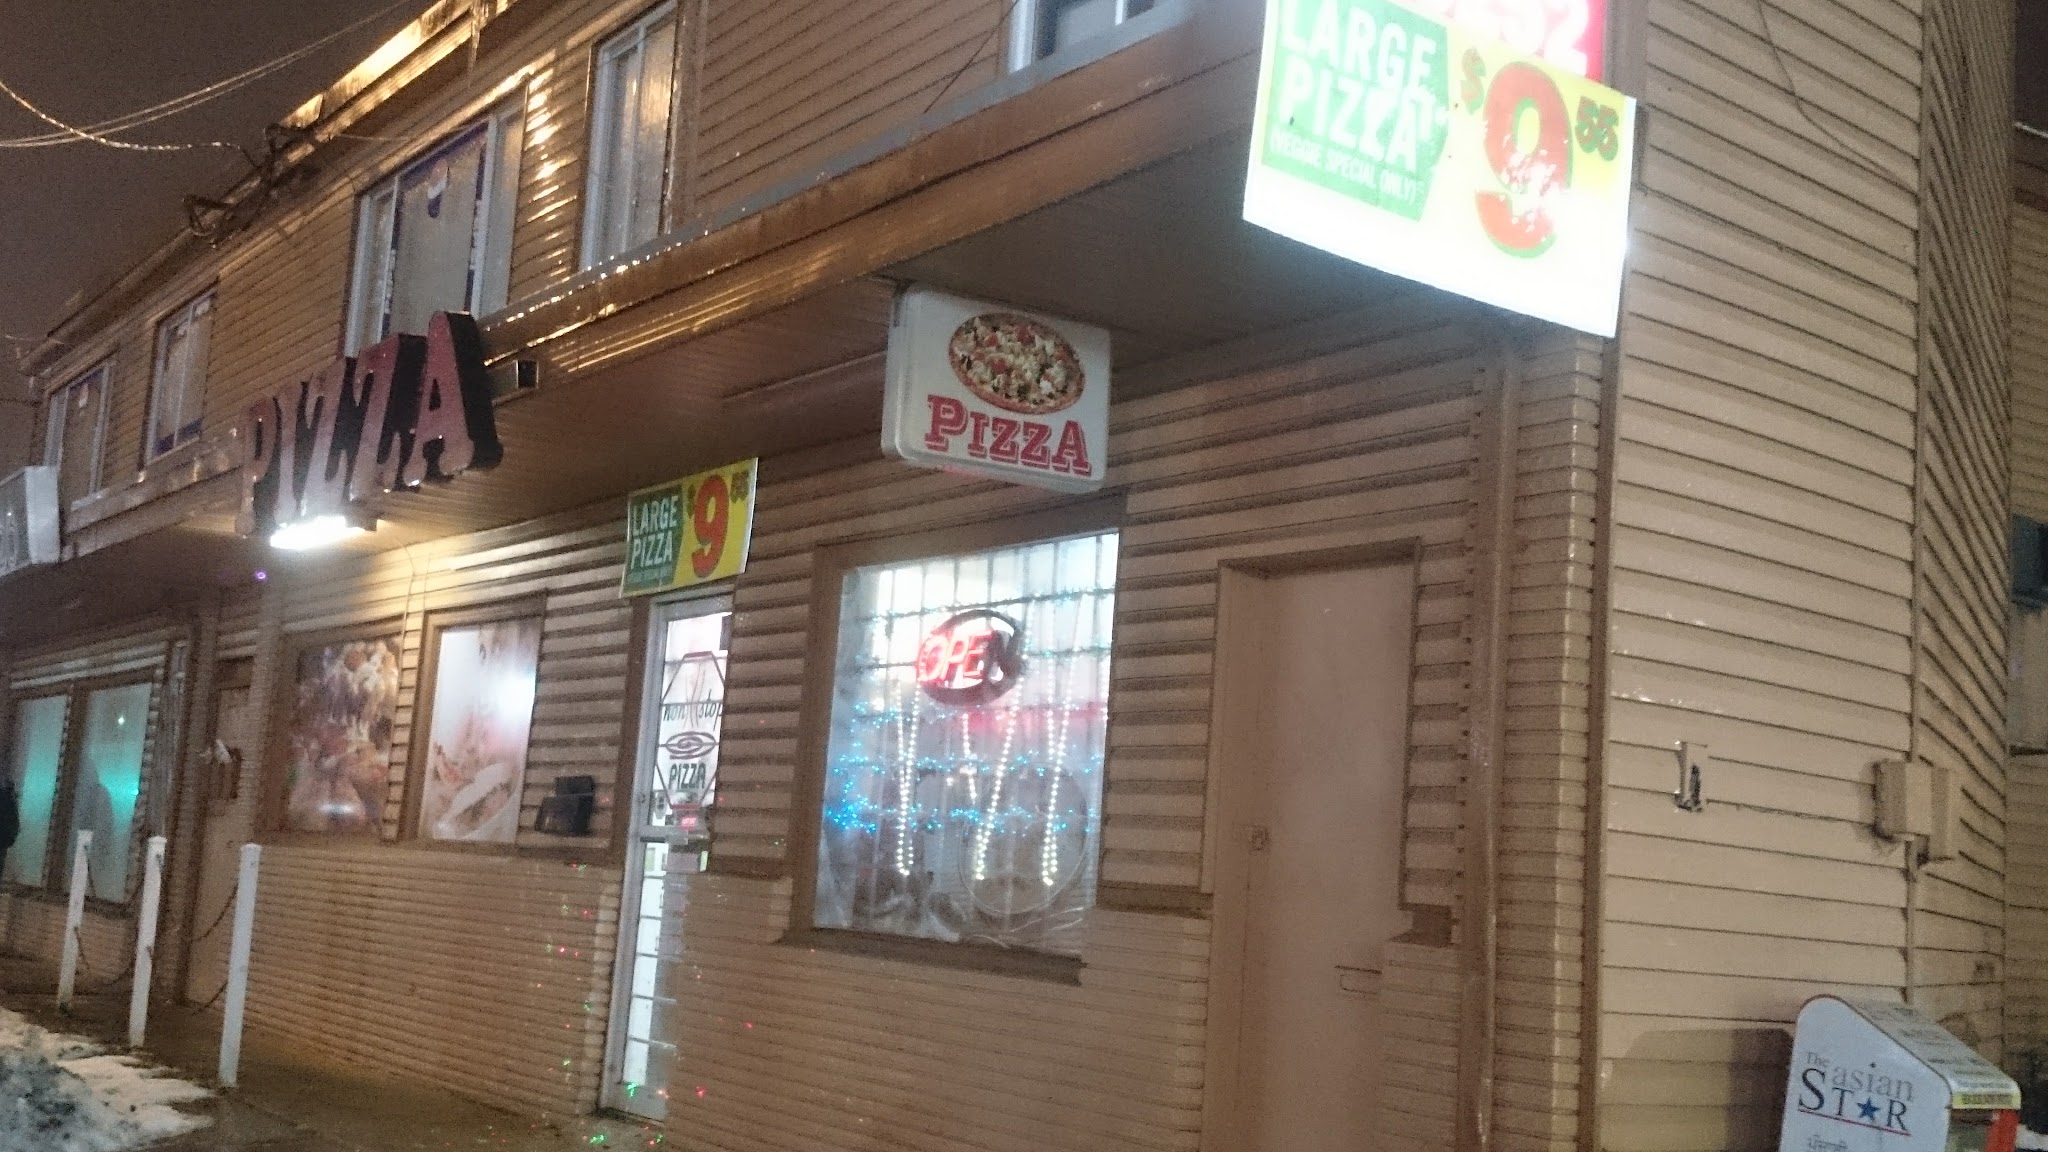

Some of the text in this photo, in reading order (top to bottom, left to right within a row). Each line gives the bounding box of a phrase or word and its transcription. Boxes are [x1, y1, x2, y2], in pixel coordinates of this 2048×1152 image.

[1281, 0, 1437, 89] LARGE
[1278, 53, 1418, 173] PIZZA
[924, 393, 1093, 478] PIZZA
[632, 496, 679, 536] LARGE
[630, 530, 673, 570] PIZZA
[917, 628, 1010, 684] OPE
[669, 762, 707, 789] PIZZA
[1831, 1062, 1915, 1102] asian
